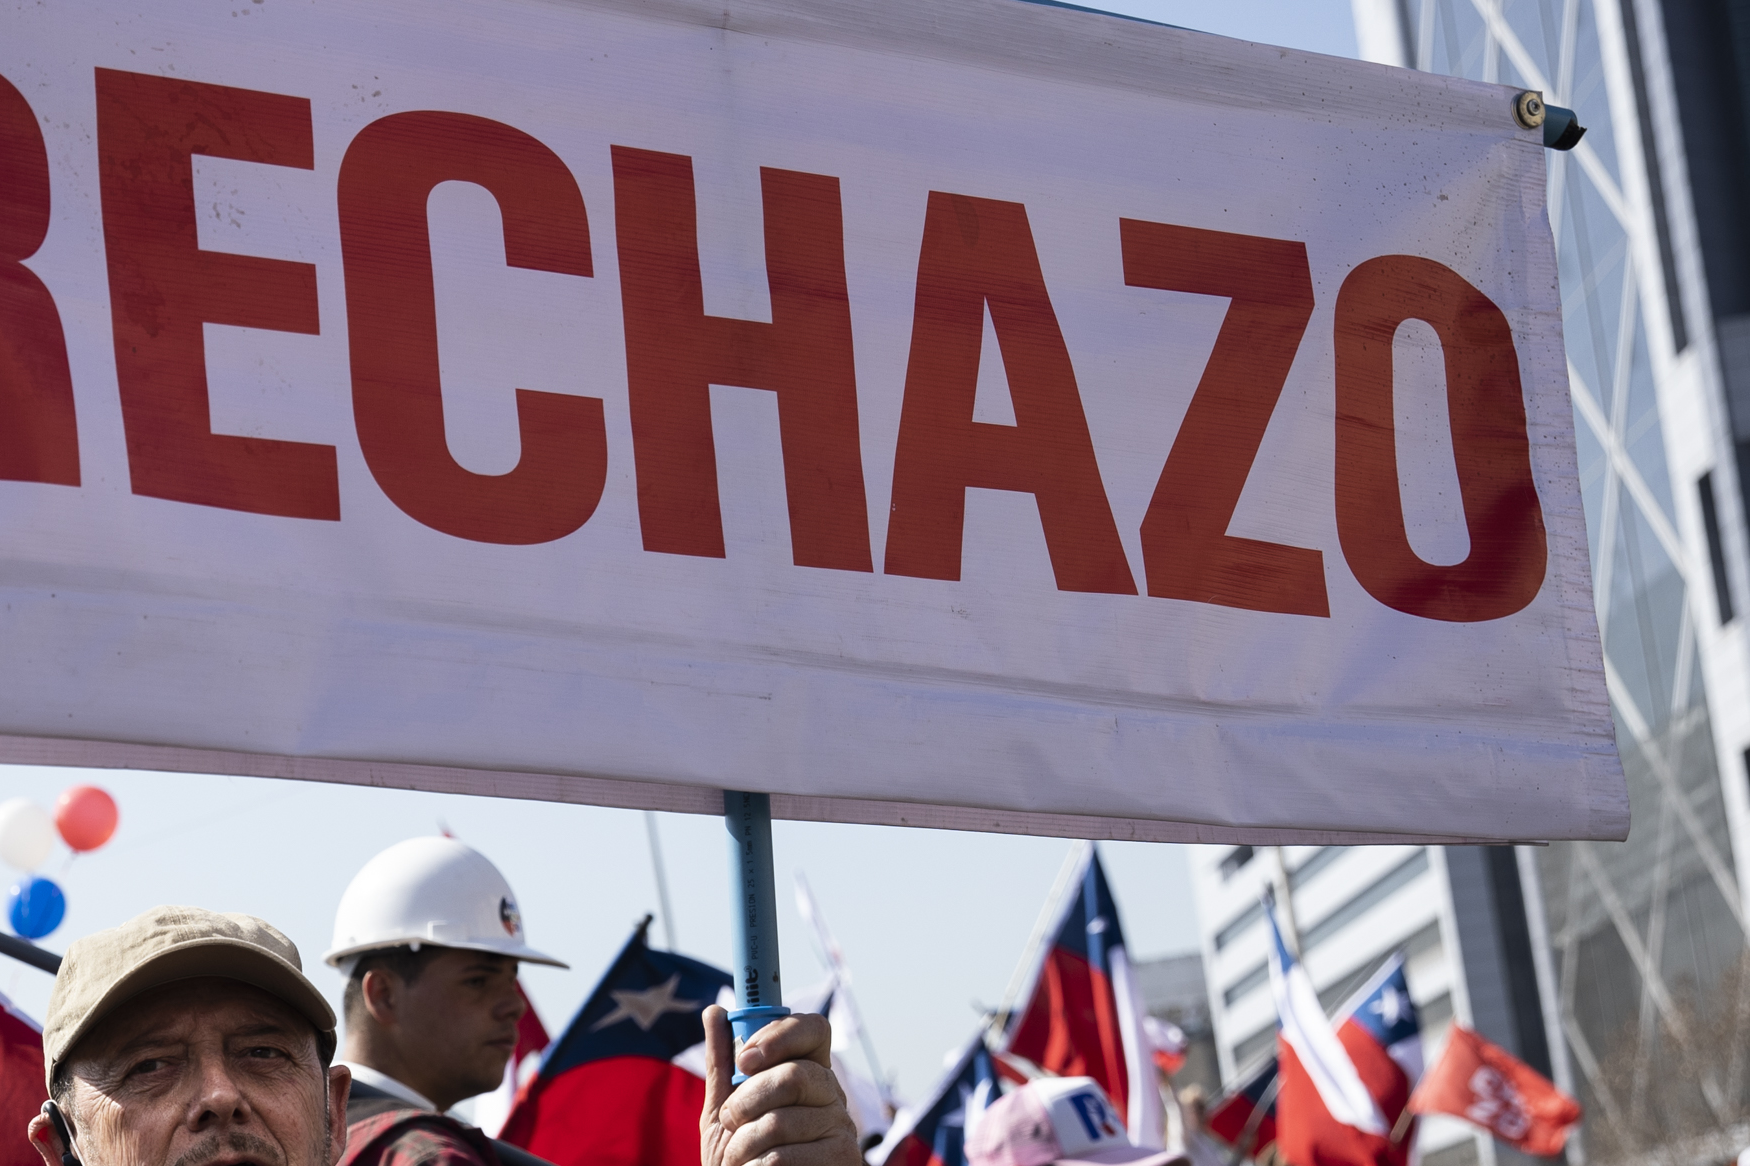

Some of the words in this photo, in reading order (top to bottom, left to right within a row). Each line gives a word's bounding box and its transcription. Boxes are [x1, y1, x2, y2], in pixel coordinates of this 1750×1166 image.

[745, 825, 752, 836] PN
[747, 879, 755, 888] 25
[748, 893, 757, 928] PRESION
